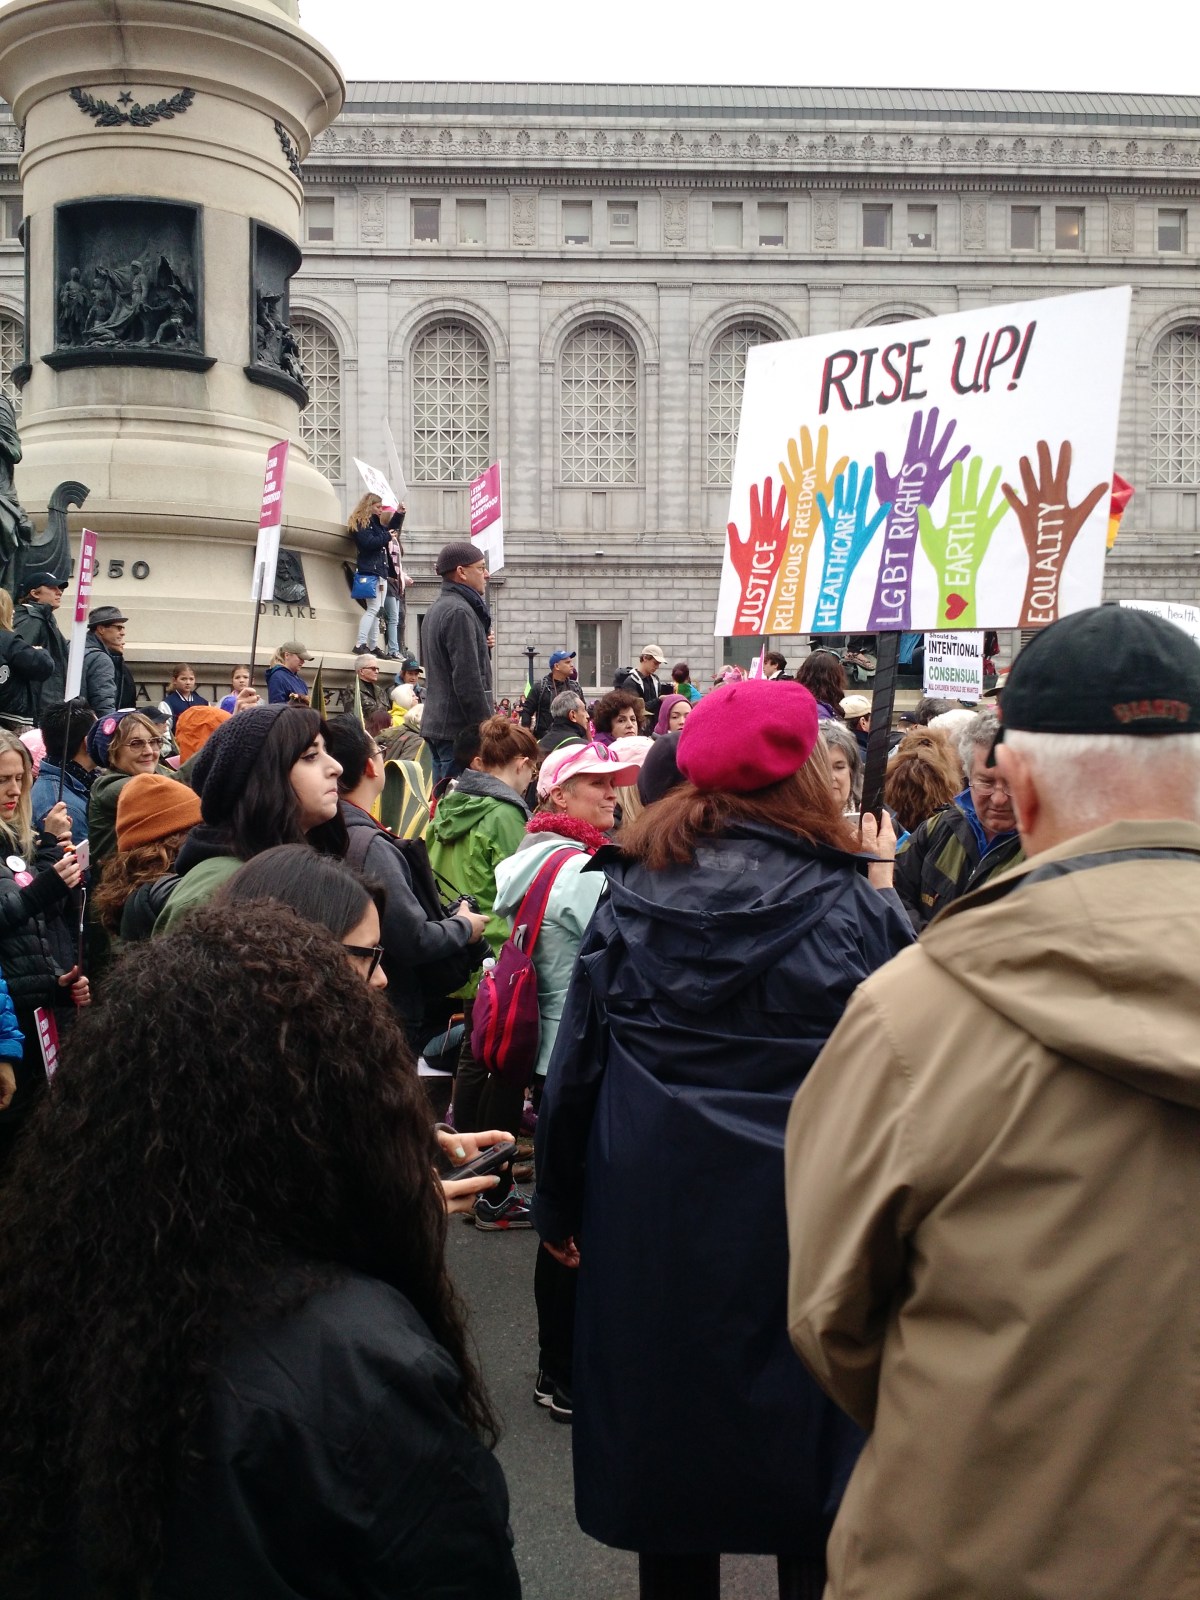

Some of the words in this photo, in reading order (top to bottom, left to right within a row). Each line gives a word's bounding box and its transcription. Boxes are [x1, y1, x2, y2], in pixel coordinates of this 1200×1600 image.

[818, 339, 931, 415] RISE
[950, 320, 1038, 395] UP!
[890, 461, 928, 541] RIGHTS
[739, 539, 777, 631] JUSTICE
[773, 542, 806, 632] RELIGIOUS
[797, 465, 818, 540] FREEDOM
[816, 508, 858, 627] HEALTHCARE
[875, 546, 909, 625] LGBT
[945, 509, 977, 587] EARTH
[1027, 502, 1066, 624] EQUALITY
[258, 602, 317, 620] DRAKE
[928, 640, 979, 658] INTENTIONAL
[1167, 604, 1199, 623] health
[928, 665, 980, 685] CONSENSUAL
